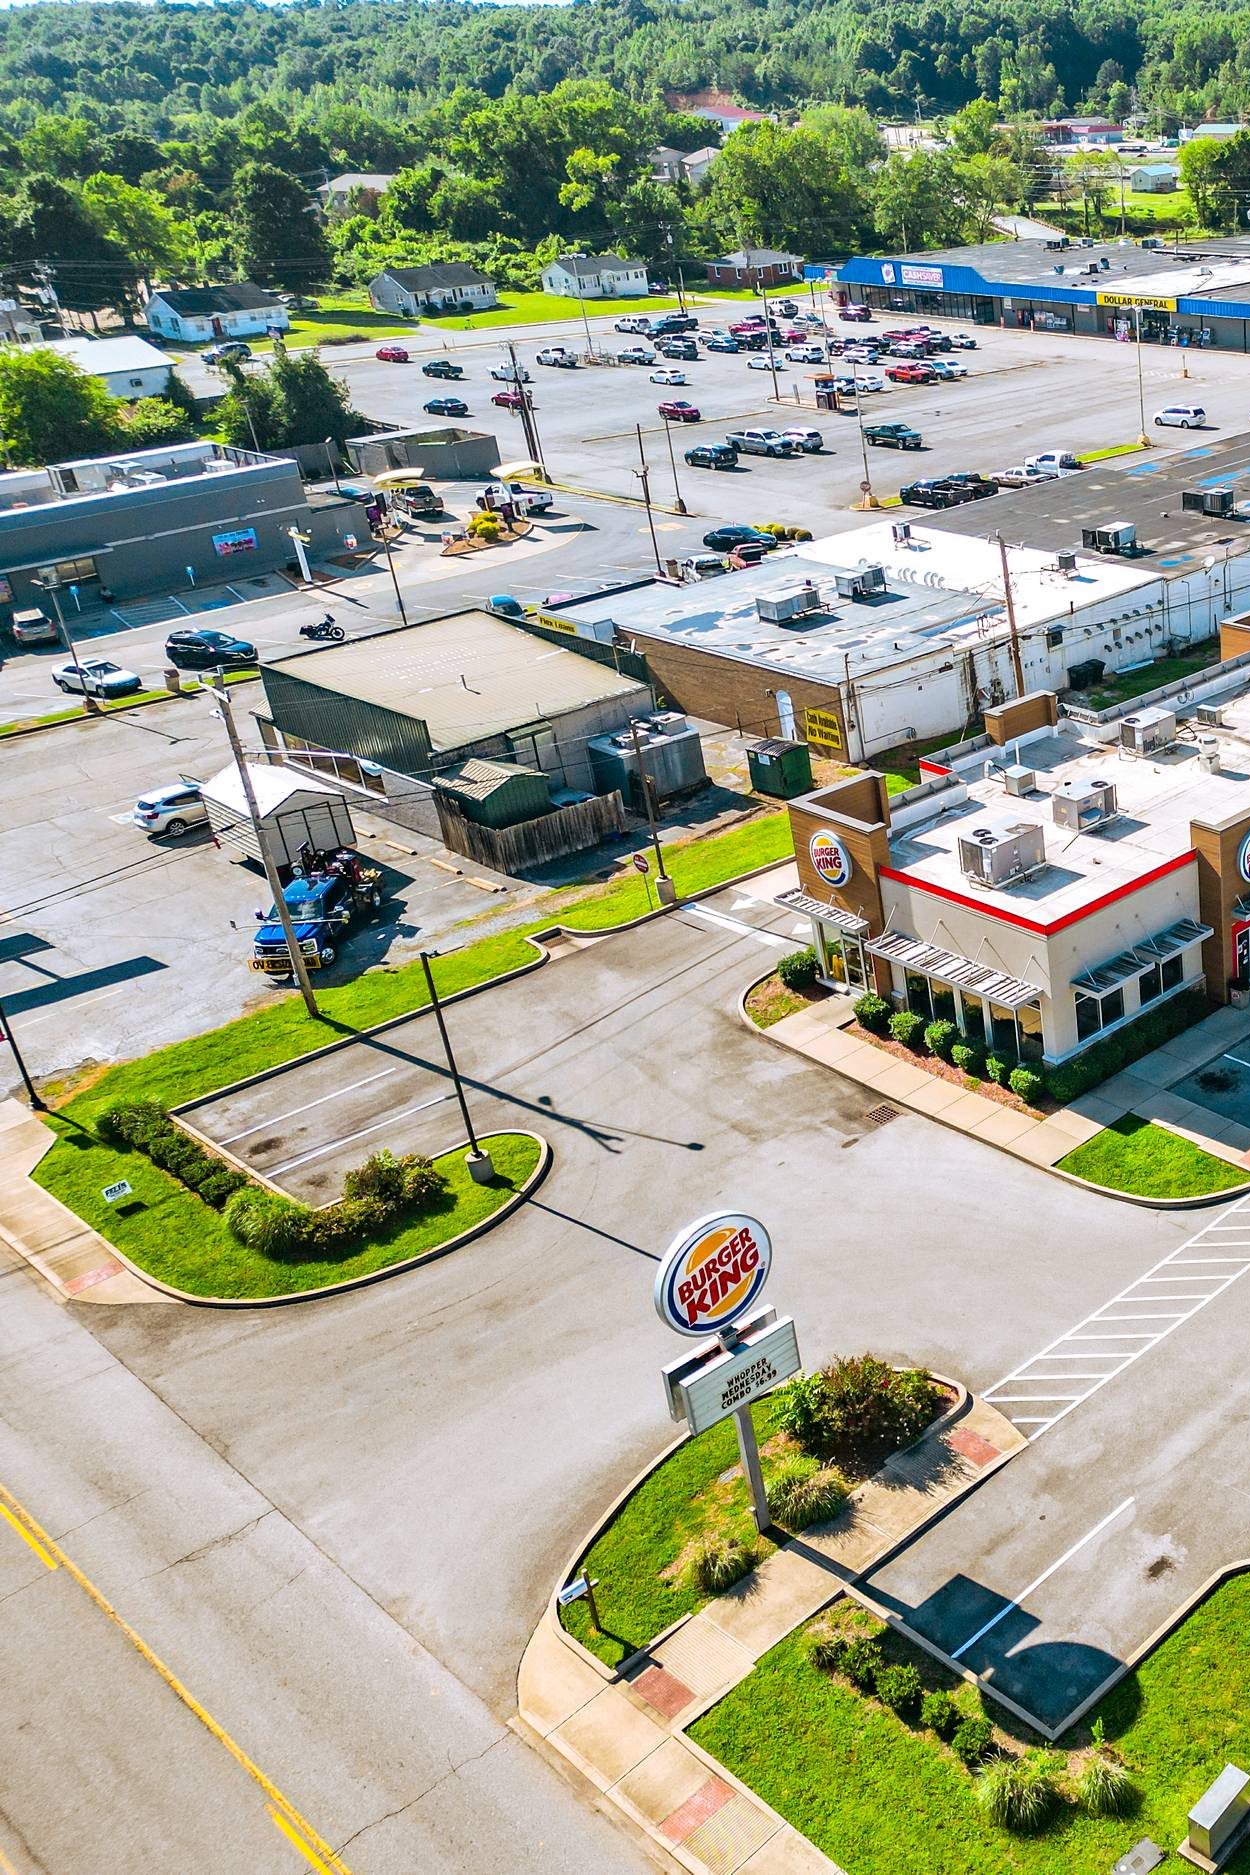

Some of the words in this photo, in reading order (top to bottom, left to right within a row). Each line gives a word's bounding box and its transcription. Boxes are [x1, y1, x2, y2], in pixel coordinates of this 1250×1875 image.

[1104, 296, 1132, 305] DOLLAR
[1135, 298, 1168, 309] GENERAL
[808, 726, 817, 737] No
[817, 728, 840, 746] Waiting
[813, 847, 840, 857] BURGER
[815, 856, 842, 870] KING
[677, 1227, 753, 1305] BURGER
[687, 1241, 760, 1327] KING
[727, 1358, 767, 1388] WHOPPER
[721, 1386, 751, 1409] COMBO
[755, 1369, 777, 1388] $6.99
